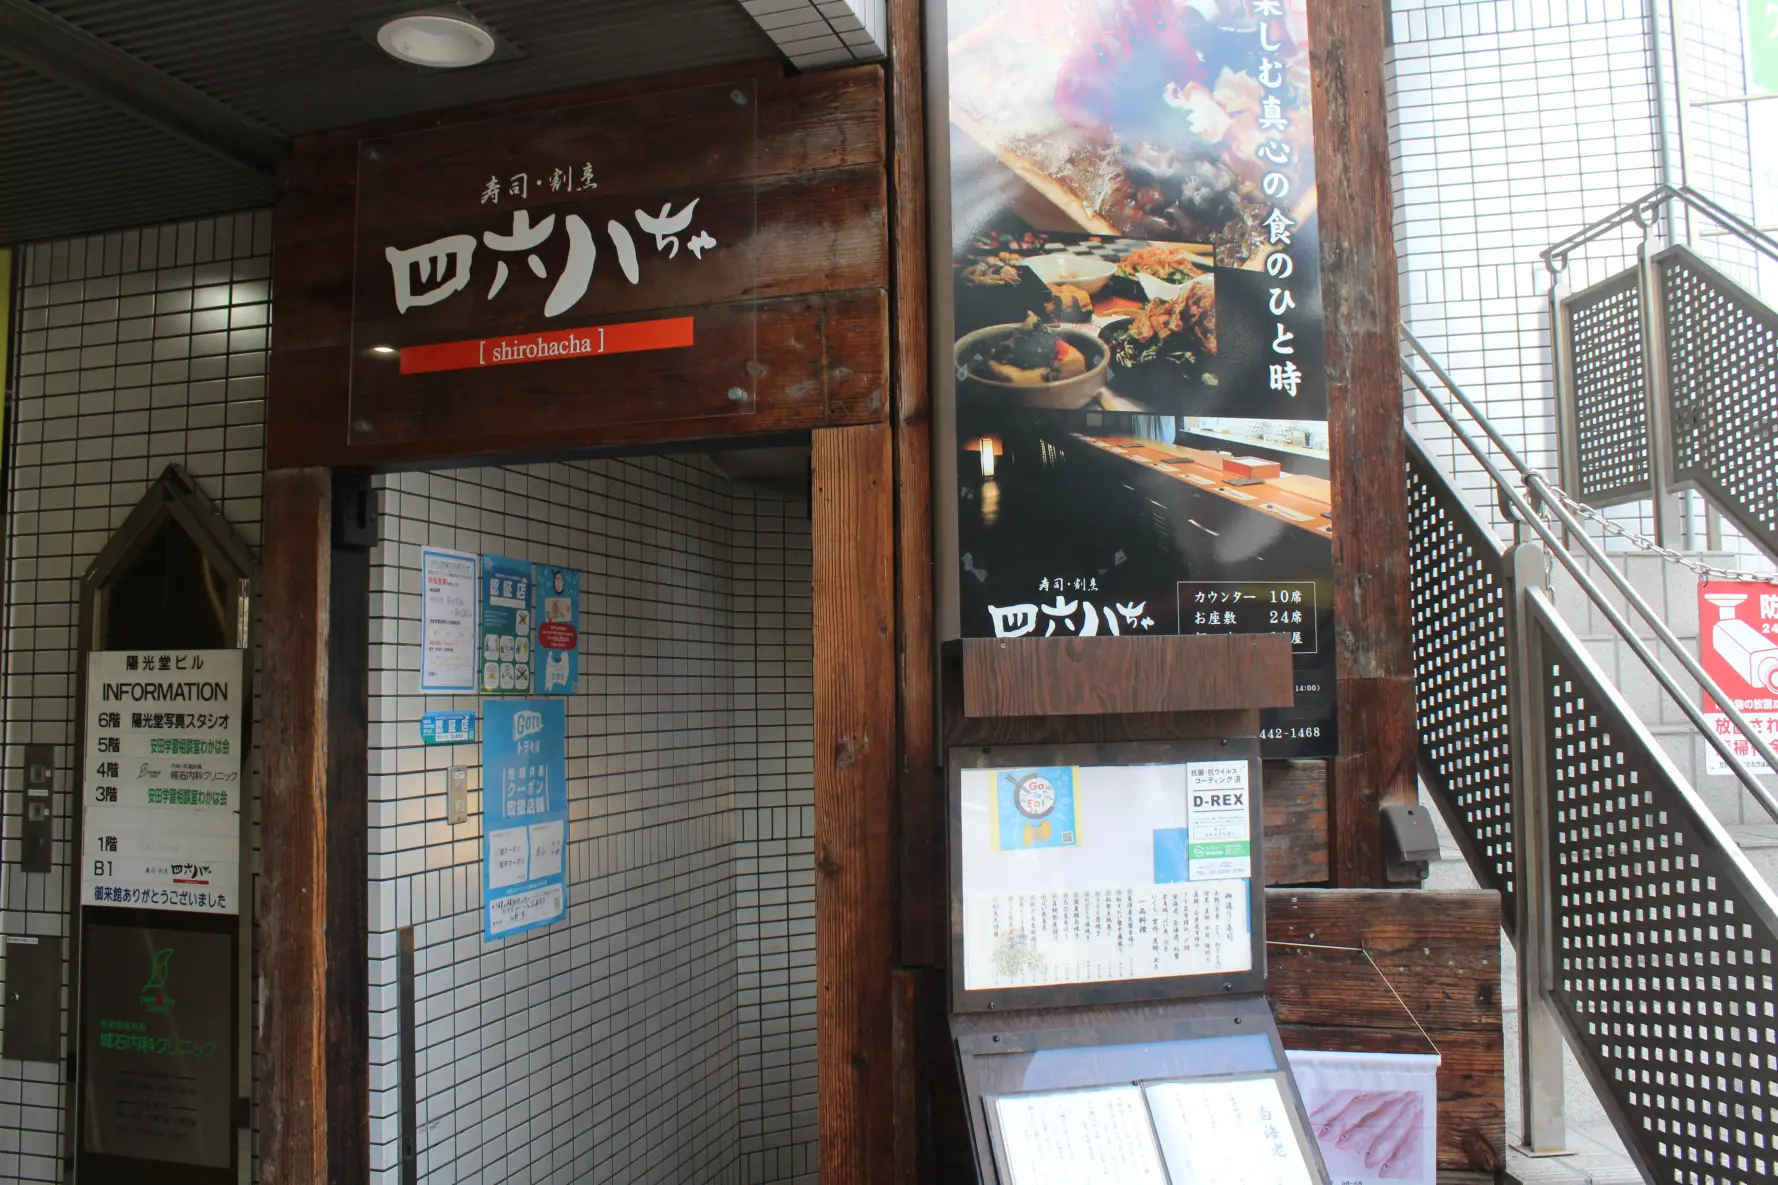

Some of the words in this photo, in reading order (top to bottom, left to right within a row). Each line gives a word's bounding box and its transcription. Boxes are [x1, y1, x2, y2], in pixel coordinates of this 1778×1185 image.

[1194, 591, 1257, 604] カウンター
[1269, 590, 1303, 604] 10席
[1194, 611, 1237, 625] お座敷
[1269, 611, 1303, 625] 24席
[126, 654, 204, 671] 陽光堂ビル
[102, 682, 228, 702] INFORMATION
[98, 712, 121, 729] 6階
[131, 713, 230, 730] 陽光堂写真スタジオ
[97, 737, 120, 753] 5階
[96, 762, 119, 778] 4階
[508, 779, 544, 798] クーポン
[1029, 781, 1045, 791] Go
[95, 787, 118, 803] 3階
[1193, 793, 1244, 808] D-REX
[97, 836, 118, 852] 1階
[94, 861, 113, 877] B1
[94, 886, 226, 909] 御来館ありがとうございました
